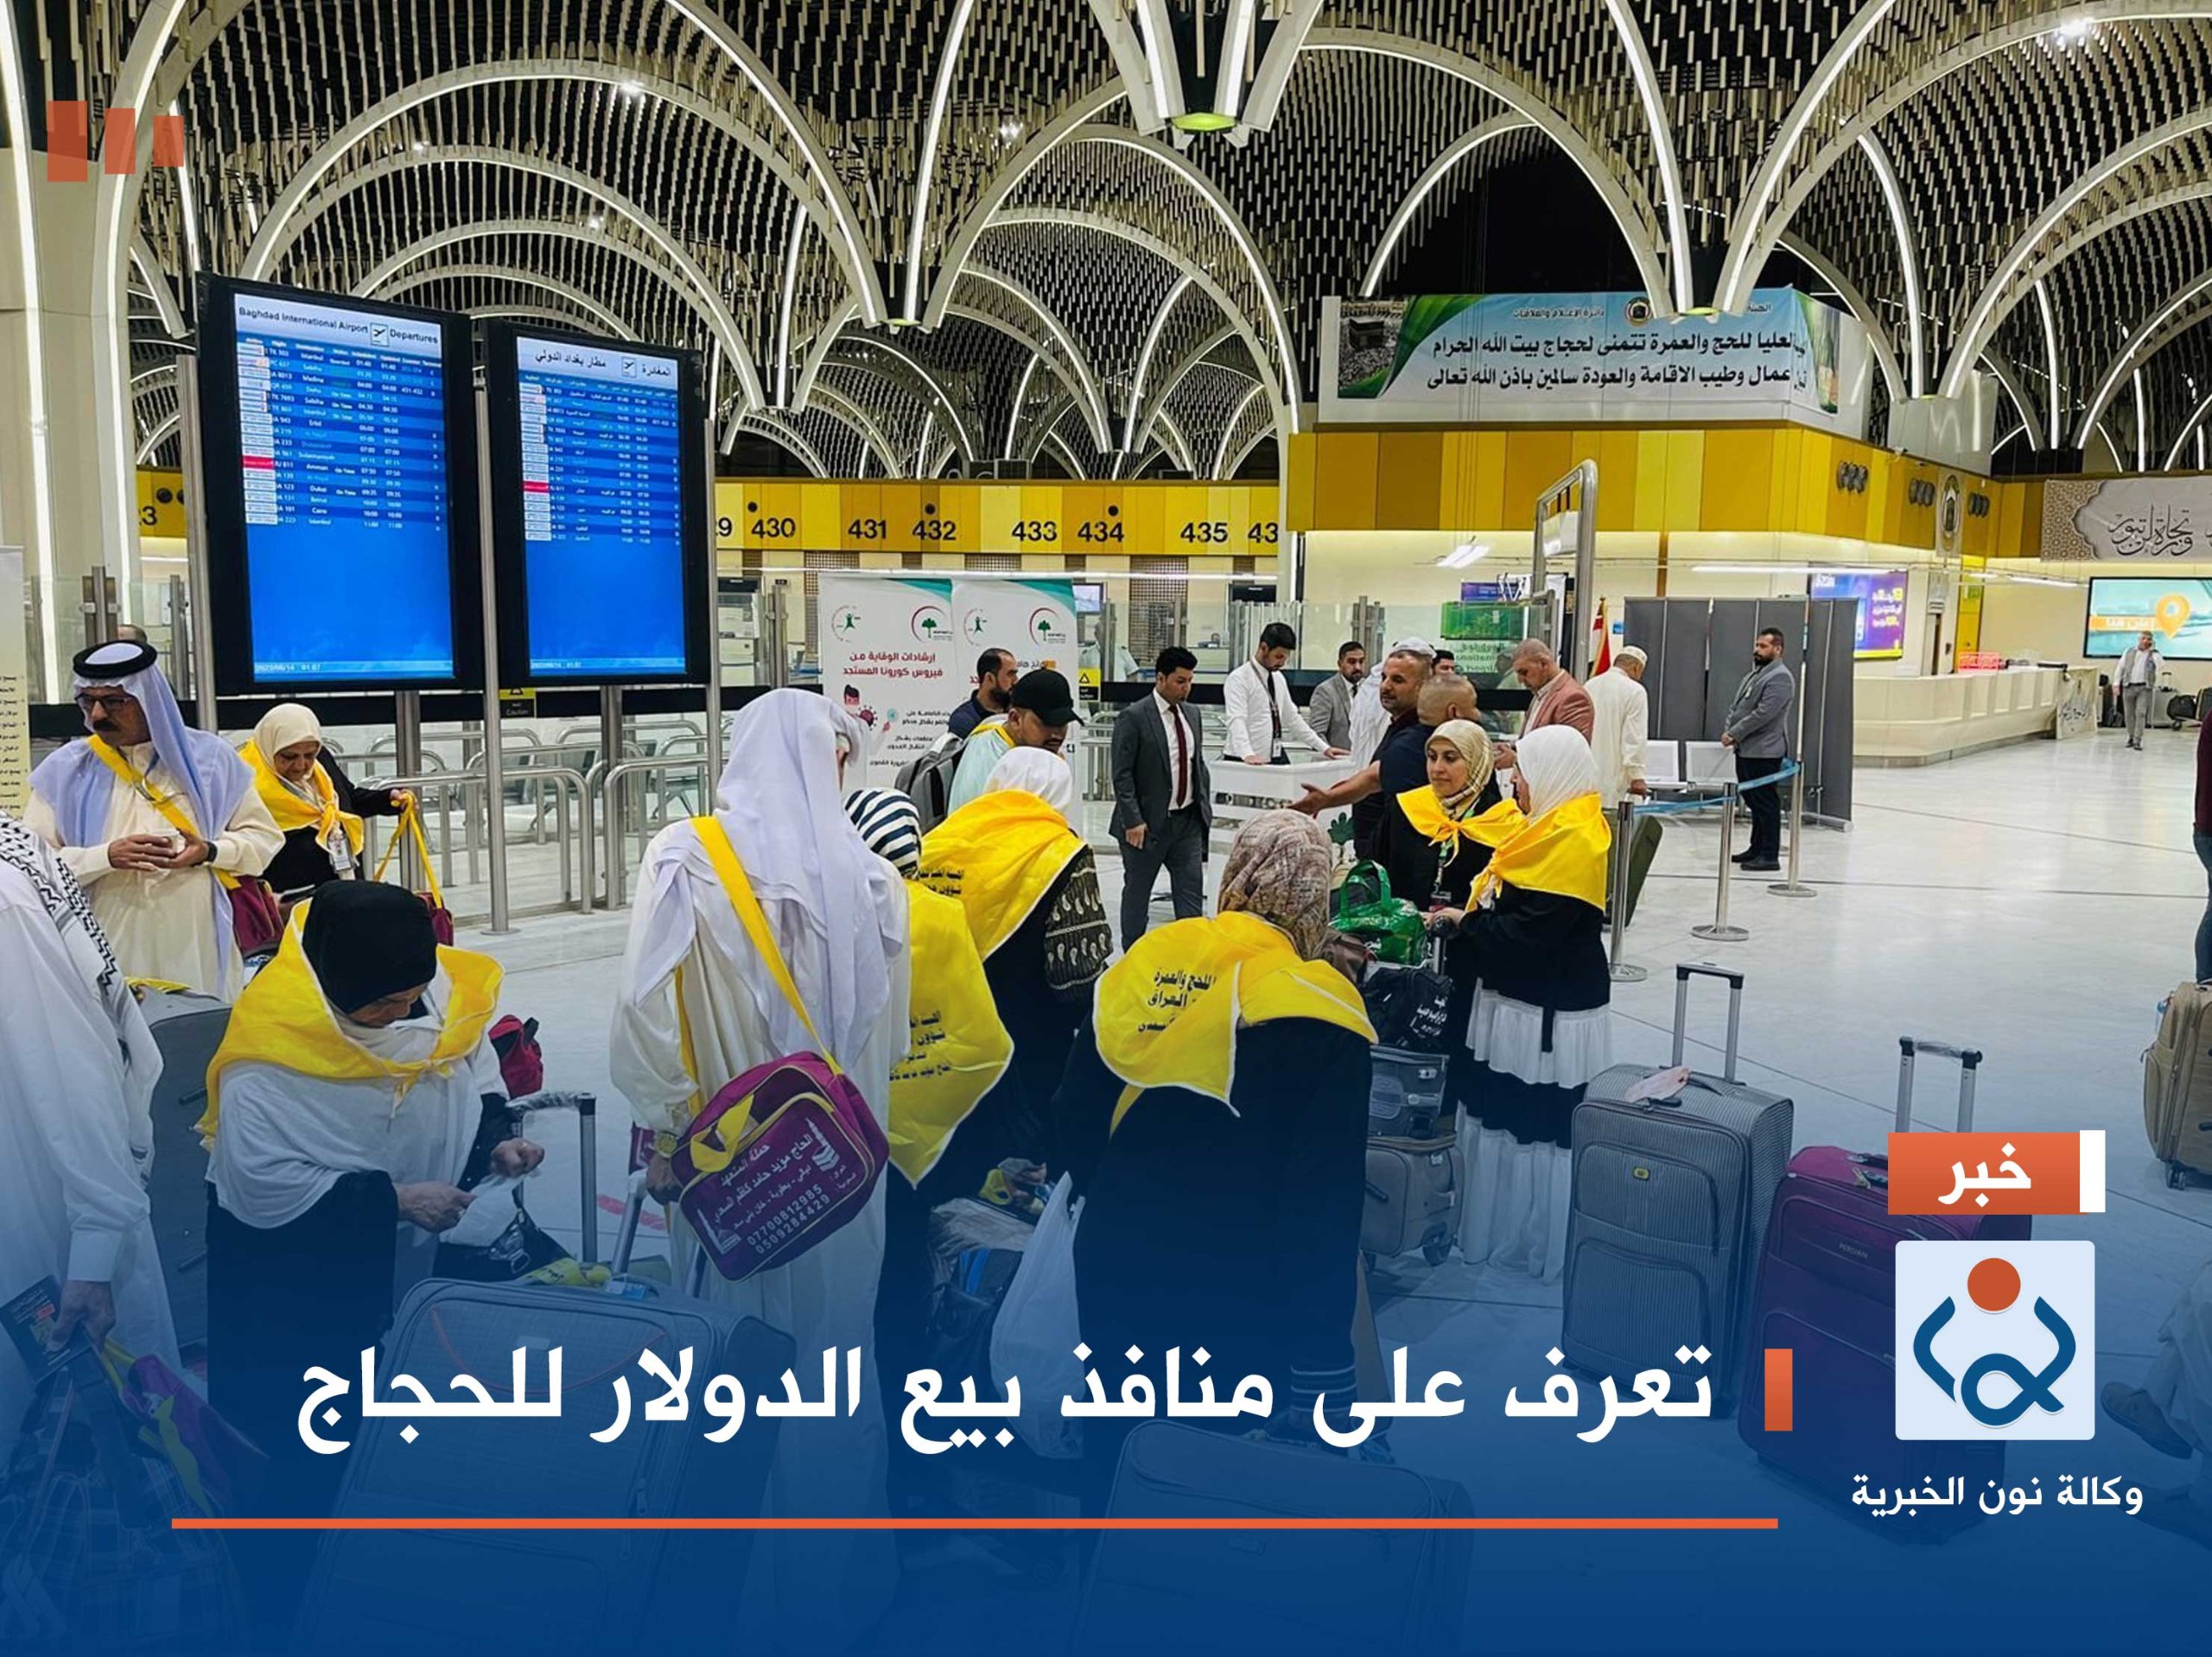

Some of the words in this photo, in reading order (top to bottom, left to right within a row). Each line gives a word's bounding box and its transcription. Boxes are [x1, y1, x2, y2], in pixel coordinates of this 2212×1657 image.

[238, 307, 280, 321] Baghdad
[282, 312, 337, 329] International
[338, 321, 369, 334] Airport
[389, 328, 438, 345] Departures
[1433, 335, 1478, 358] الحرام
[1482, 332, 1507, 352] الله
[1510, 335, 1540, 357] بيت
[1543, 335, 1593, 357] لحجاج
[1598, 333, 1646, 356] تتمنى
[1649, 332, 1709, 355] والعمرة
[1712, 332, 1752, 354] للحج
[535, 348, 562, 363] الدولي
[563, 352, 584, 368] بغداد
[587, 357, 607, 369] مطار
[641, 364, 671, 377] المغادرة
[1427, 366, 1467, 389] تعالى
[1471, 364, 1497, 385] الله
[1499, 366, 1534, 390] باذن
[1536, 366, 1579, 389] سالمين
[1583, 366, 1636, 389] والعودة
[1641, 365, 1695, 384] الاقامة
[1699, 365, 1745, 388] وطيب
[751, 517, 797, 539] 430
[848, 517, 887, 540] 431
[912, 517, 957, 542] 432
[1011, 519, 1058, 543] 433
[1077, 519, 1124, 543] 434
[1179, 521, 1228, 544] 435
[1248, 522, 1278, 544] 43
[849, 652, 866, 662] من
[868, 651, 899, 664] الوقاية
[901, 652, 936, 664] ارشادات
[843, 666, 879, 676] المستجد
[880, 667, 910, 678] كورونا
[912, 669, 944, 679] فيروس
[791, 1133, 814, 1160] الحاج
[754, 1194, 830, 1254] 0509284429
